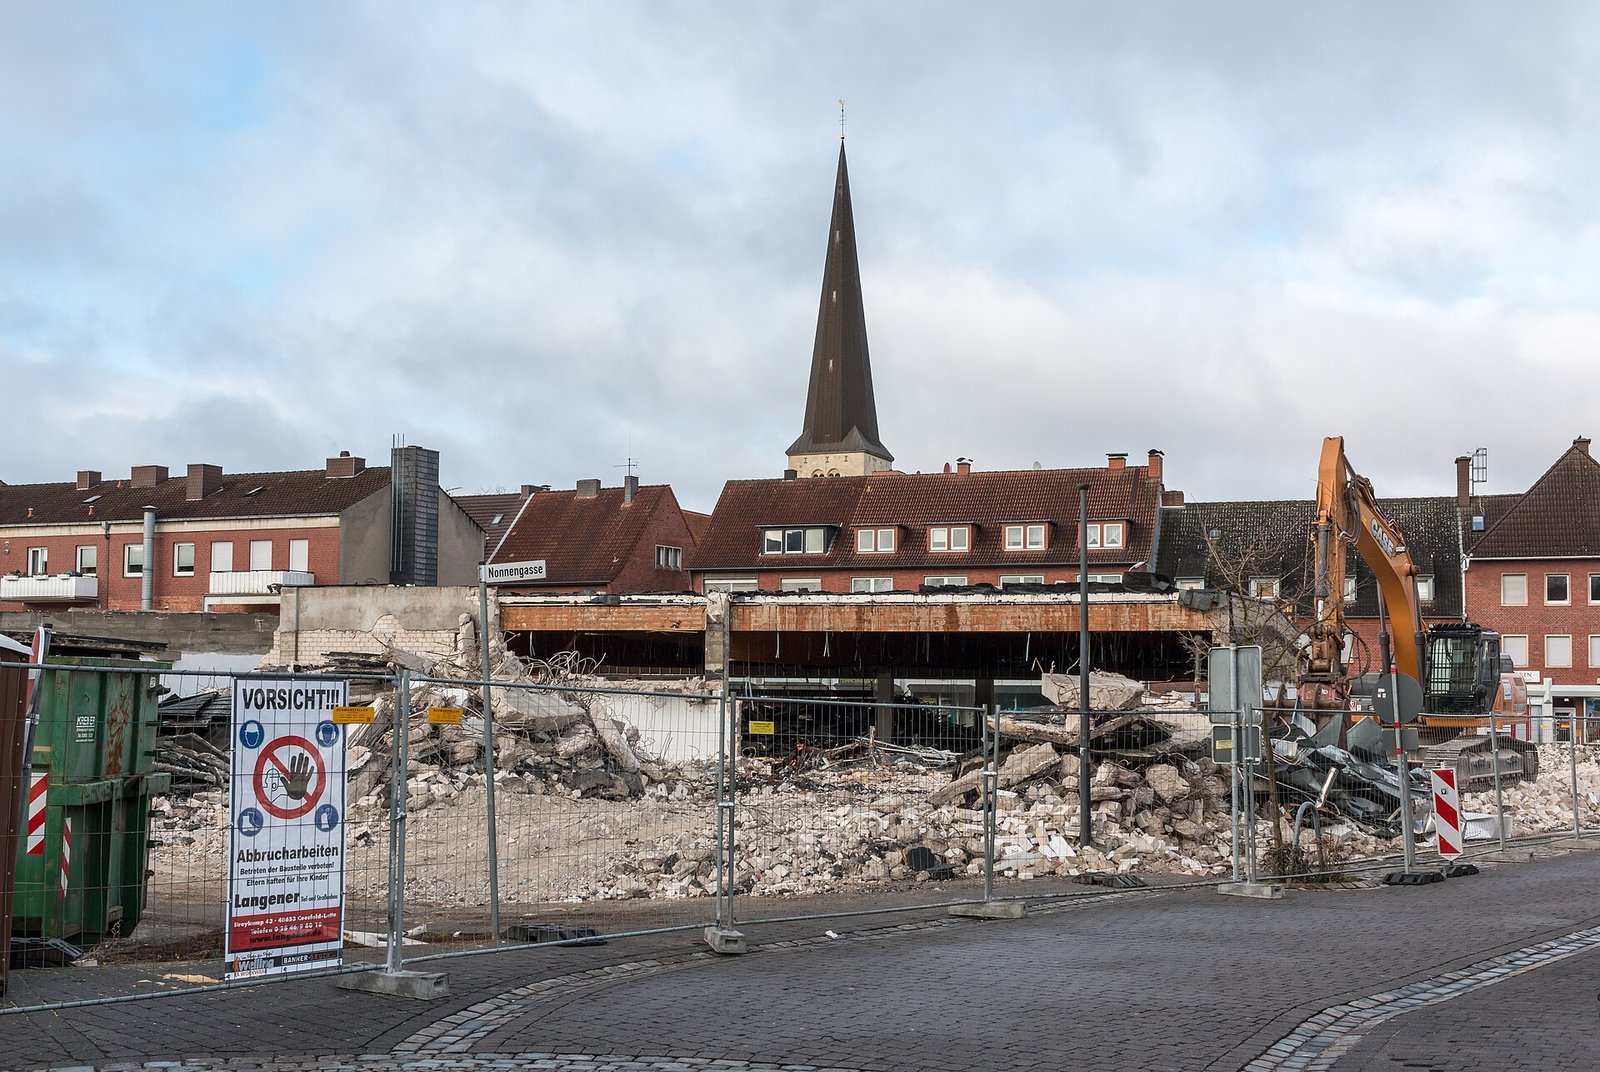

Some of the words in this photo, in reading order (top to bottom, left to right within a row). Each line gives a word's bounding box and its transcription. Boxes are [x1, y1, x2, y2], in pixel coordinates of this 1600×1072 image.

[1371, 518, 1393, 559] CASE
[488, 565, 543, 579] Nonnengasse
[242, 688, 339, 710] VORSICHT!!!
[236, 844, 339, 863] Abbrucharbeiten
[240, 867, 267, 876] Betreten
[279, 863, 307, 872] Baustelle
[308, 862, 335, 870] verboten!
[247, 879, 265, 887] Eltern
[266, 877, 286, 885] haften
[286, 875, 296, 883] für
[309, 873, 329, 881] Kinder
[234, 892, 300, 910] Langener
